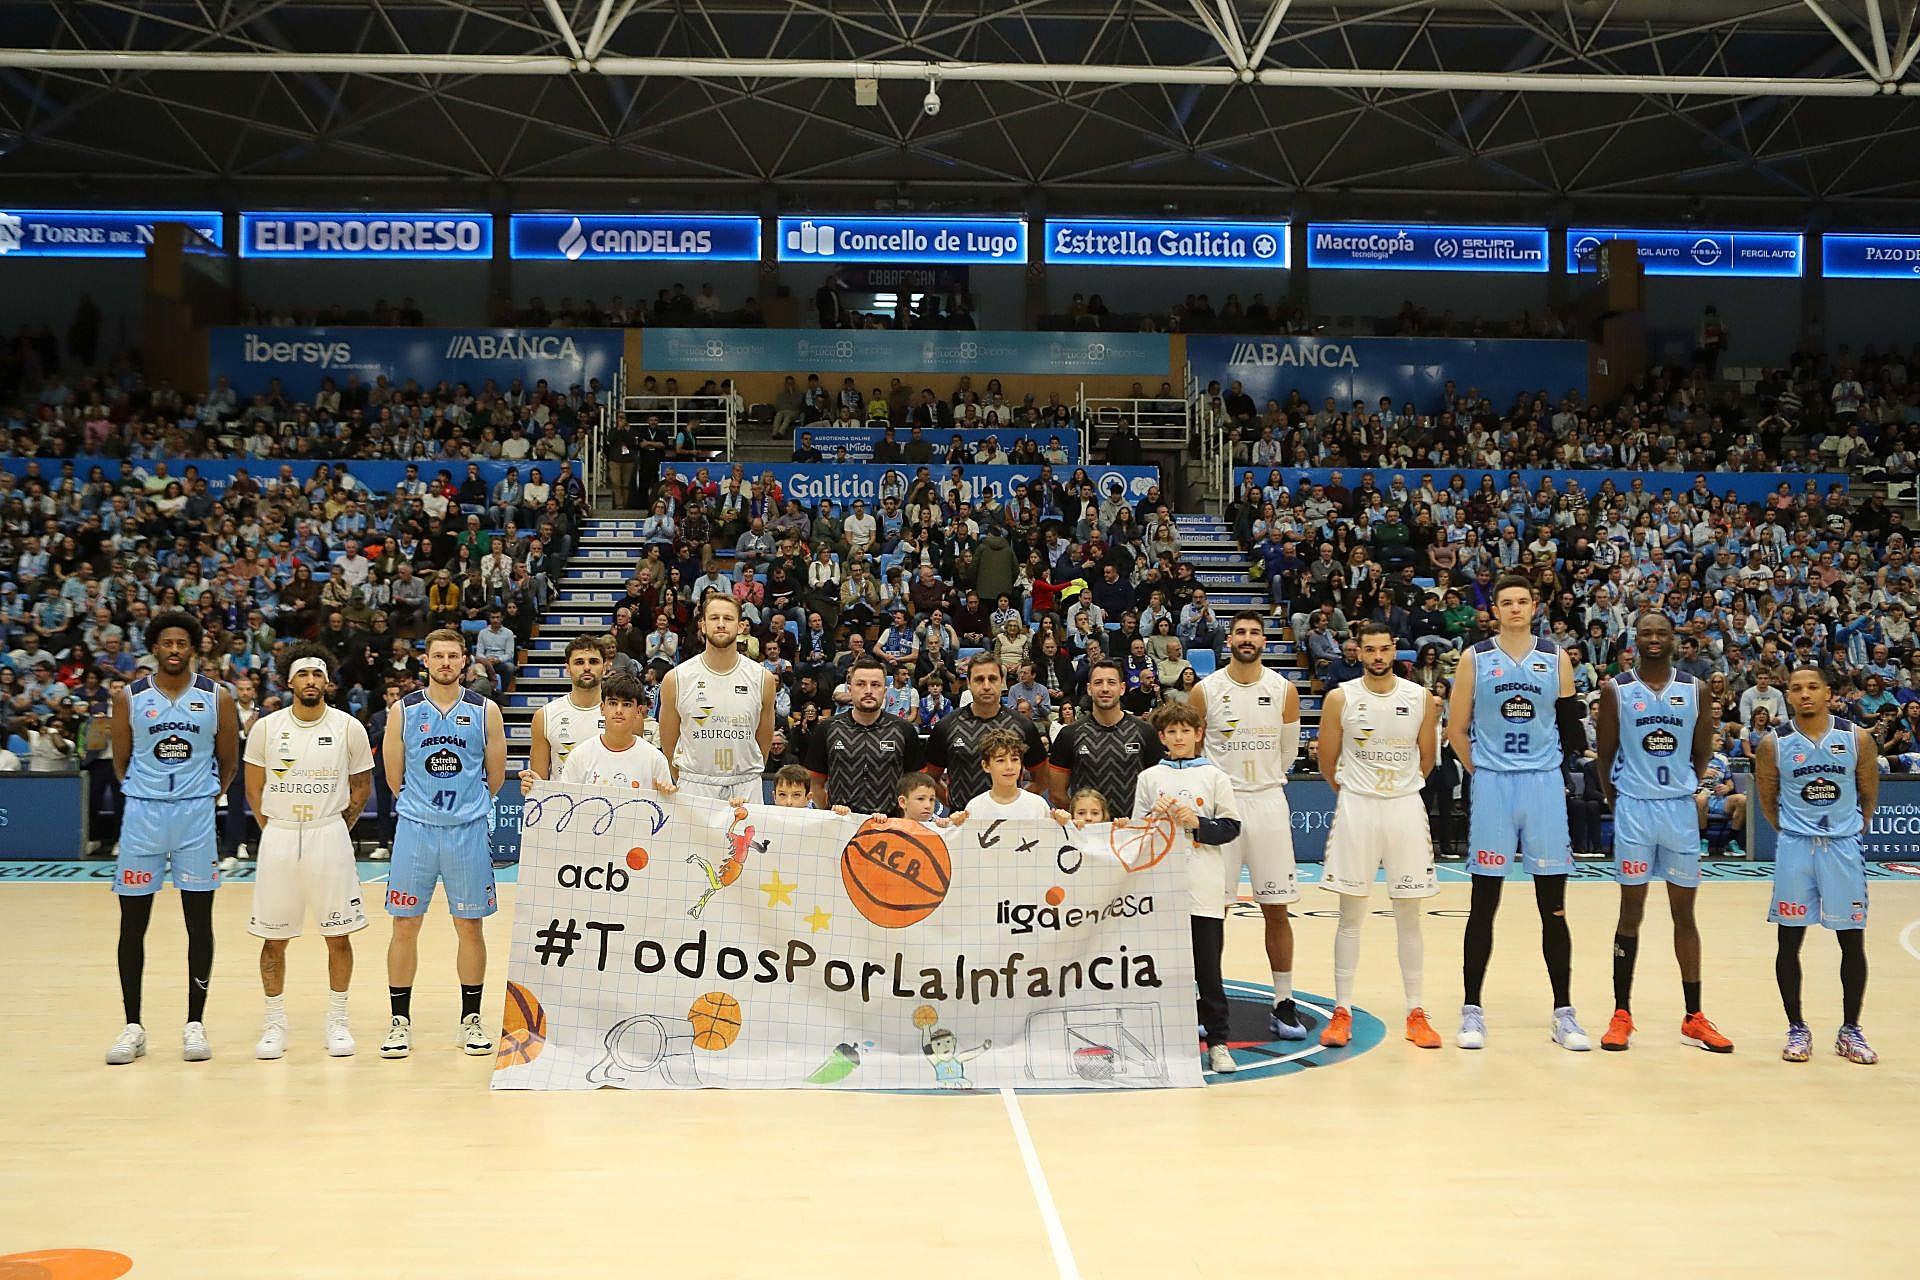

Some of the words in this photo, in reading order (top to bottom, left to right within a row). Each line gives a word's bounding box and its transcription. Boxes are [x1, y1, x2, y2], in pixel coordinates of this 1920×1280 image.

[29, 223, 105, 243] TORRE
[109, 231, 131, 242] DE
[591, 230, 712, 253] CANDELAS
[839, 229, 928, 251] Concello
[934, 229, 960, 251] de
[967, 232, 1018, 257] Lugo
[1055, 228, 1152, 255] Estrella
[1158, 230, 1247, 258] Galicia
[1462, 238, 1515, 248] GRUPO
[1655, 249, 1680, 257] AUTO
[1741, 249, 1770, 258] FERGIL
[1772, 250, 1796, 258] AUTO
[1865, 247, 1902, 260] PAZO
[244, 333, 351, 369] ibersys
[789, 473, 875, 498] Galicia
[1505, 702, 1532, 710] Estrella
[701, 729, 745, 740] BURGOS
[1647, 735, 1674, 743] Estrella
[159, 742, 188, 751] Estrella
[1504, 732, 1531, 753] 22
[1648, 742, 1674, 750] Galicia
[159, 750, 187, 758] Galicia
[431, 756, 457, 764] Estrella
[1361, 750, 1408, 762] BURGOS
[431, 763, 457, 772] Galicia
[1657, 765, 1670, 785] 0
[168, 773, 176, 792] 1
[280, 782, 330, 795] BURGOS
[1806, 784, 1836, 792] Estrella
[431, 790, 457, 811] 47
[1807, 792, 1836, 800] Galicia
[868, 840, 922, 882] ACB
[557, 861, 630, 892] acb
[534, 918, 1163, 1004] #TodosPorLaInfancia
